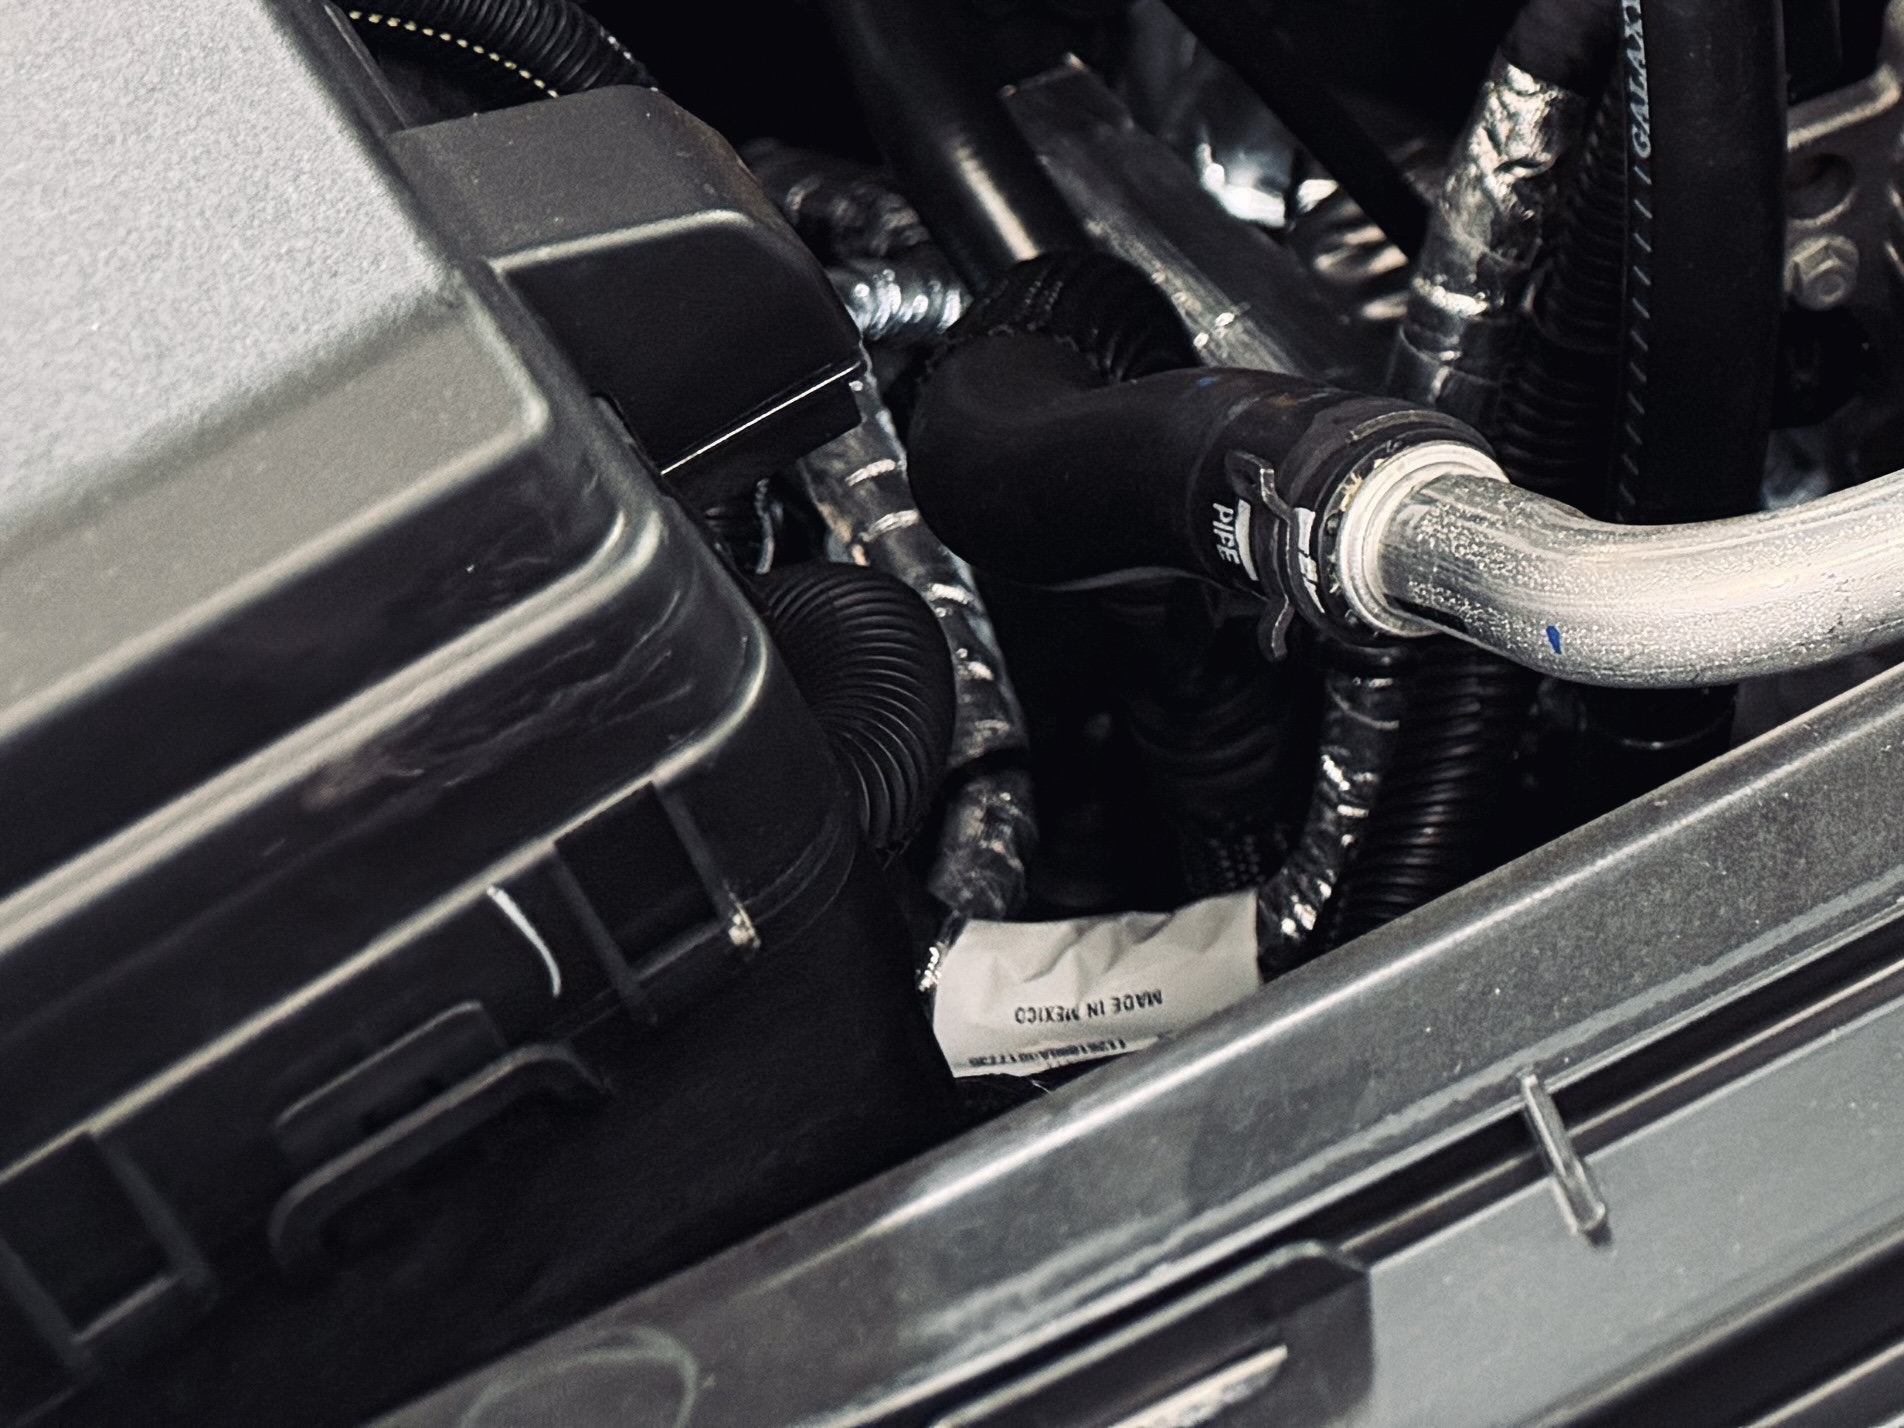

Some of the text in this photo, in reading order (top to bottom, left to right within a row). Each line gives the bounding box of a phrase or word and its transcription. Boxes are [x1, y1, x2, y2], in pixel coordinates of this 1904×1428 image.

[1212, 502, 1241, 564] PIPE
[1013, 988, 1164, 1025] MADE IN MEXICO
